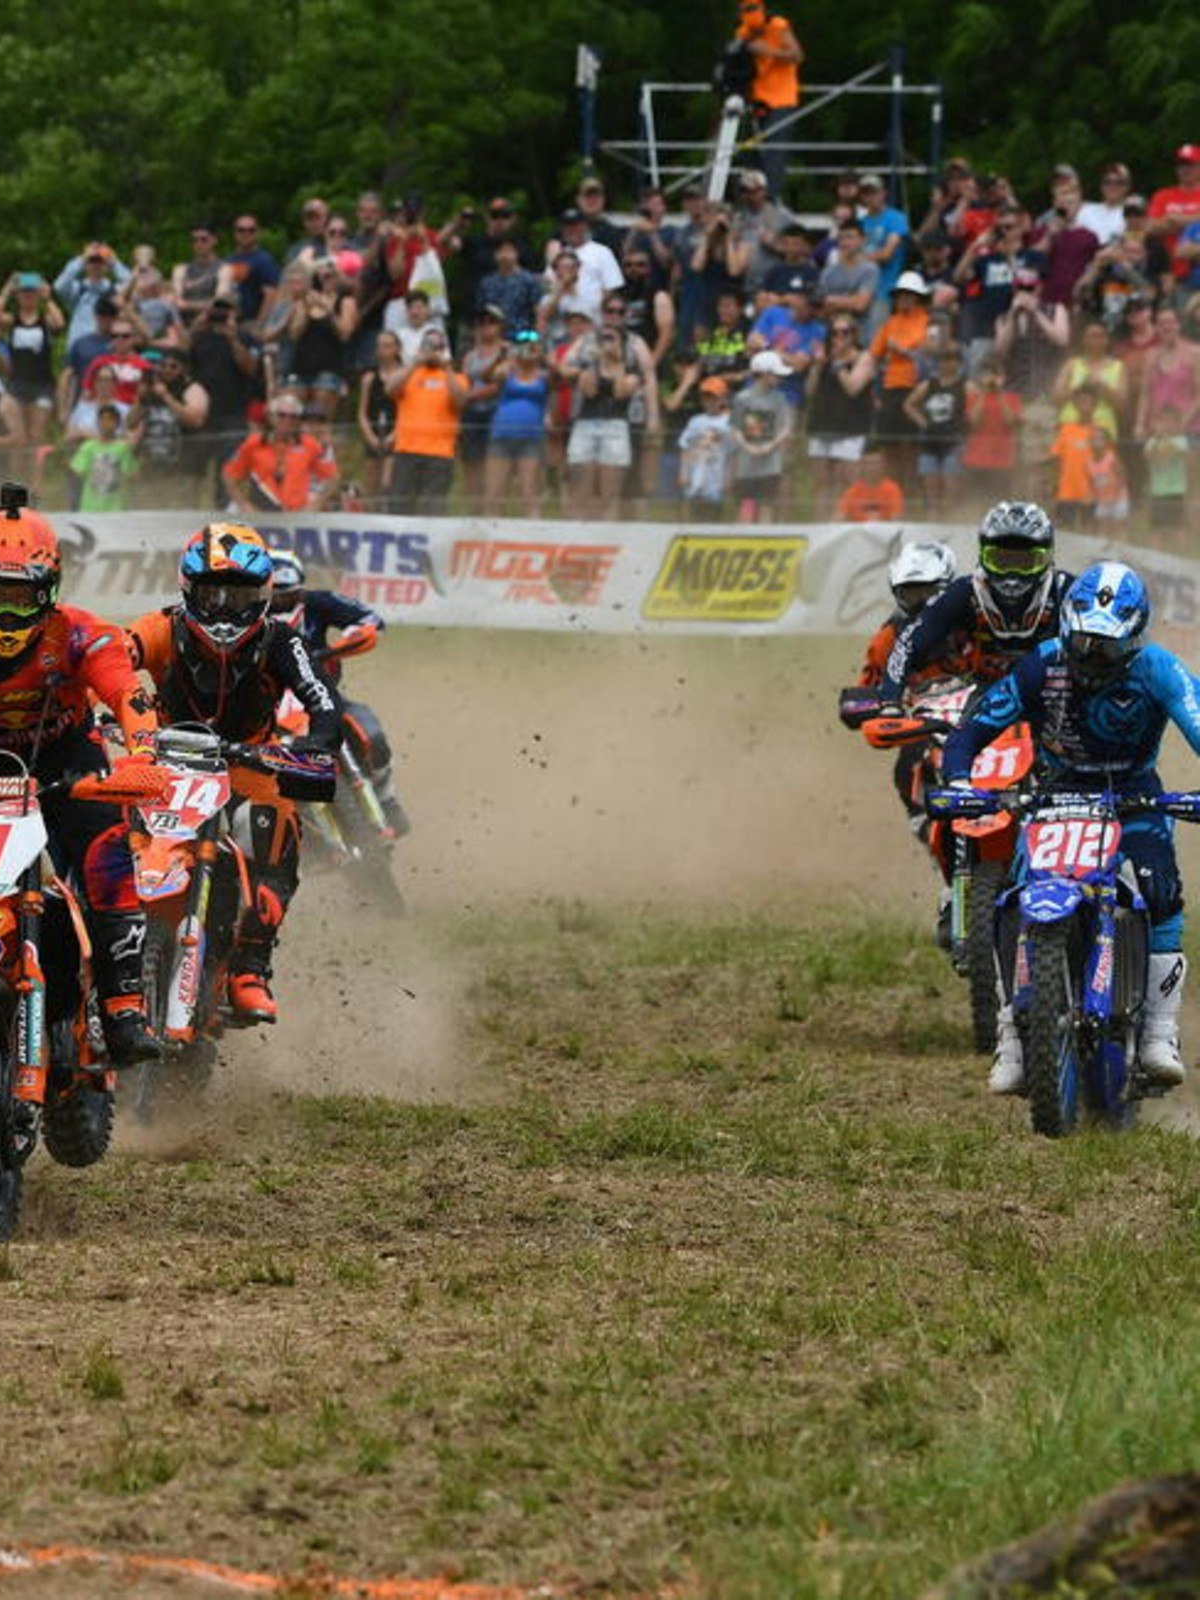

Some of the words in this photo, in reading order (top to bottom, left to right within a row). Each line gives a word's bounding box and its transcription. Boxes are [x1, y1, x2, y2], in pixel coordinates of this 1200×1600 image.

[663, 548, 795, 592] MOOSE
[168, 777, 221, 816] 14
[1030, 821, 1115, 870] 212
